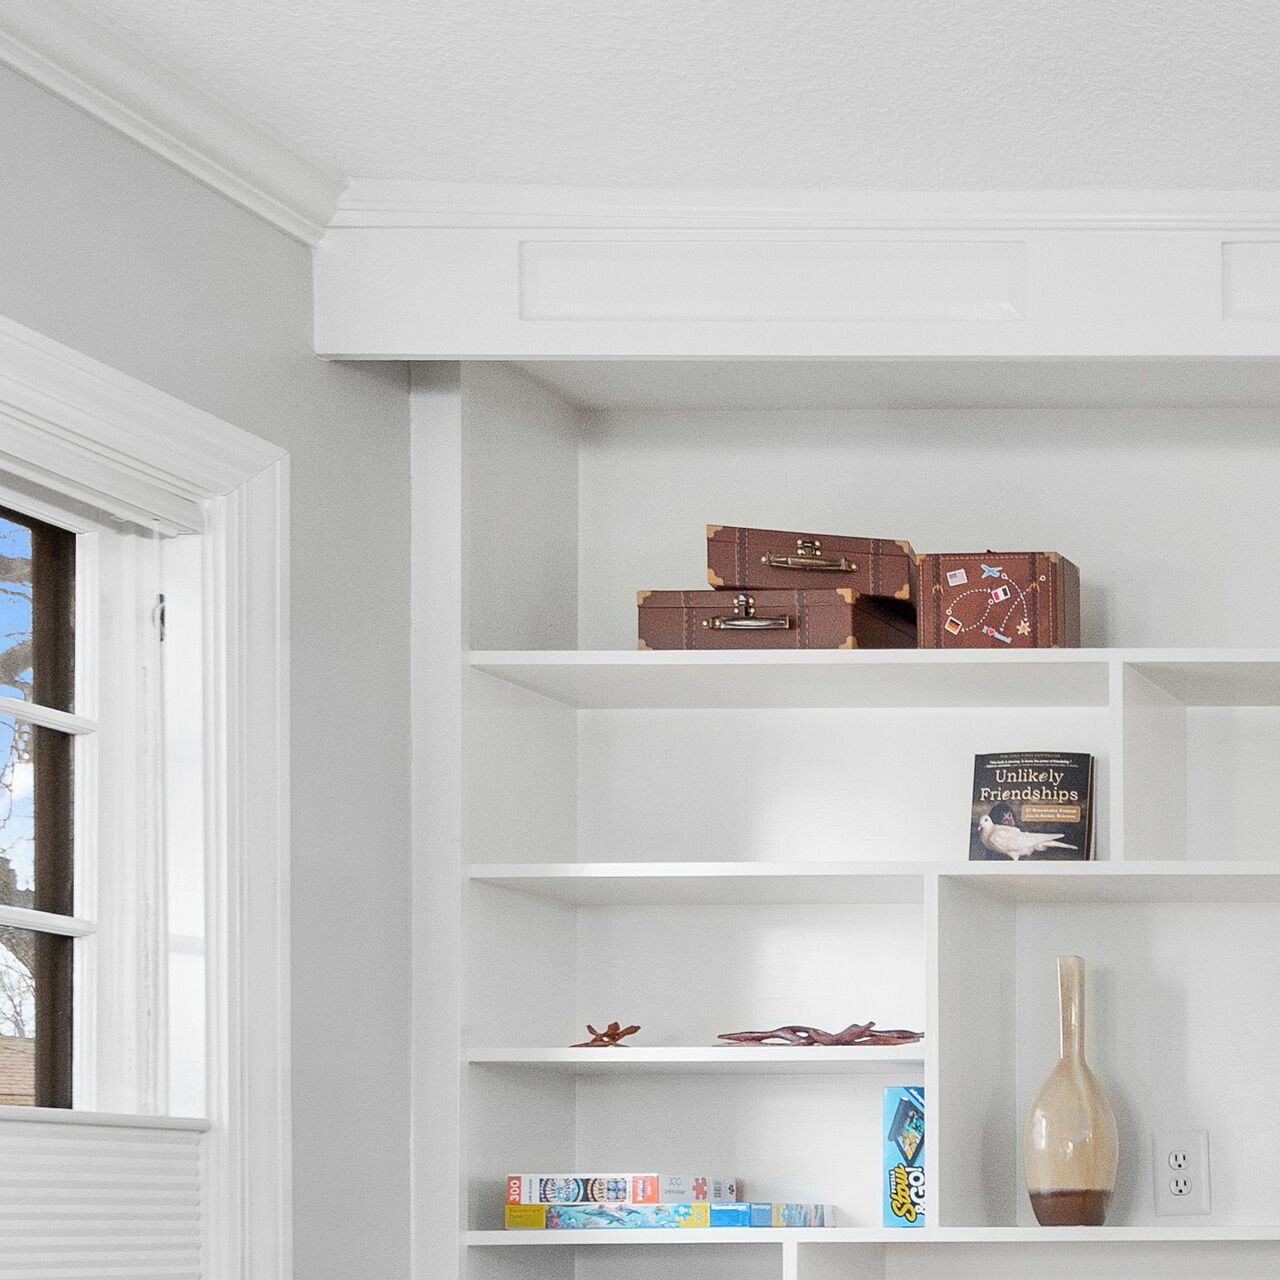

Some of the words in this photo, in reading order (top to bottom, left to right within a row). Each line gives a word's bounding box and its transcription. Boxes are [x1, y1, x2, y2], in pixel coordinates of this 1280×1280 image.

[995, 768, 1064, 785] Unlikely
[980, 786, 1078, 802] Friendships
[510, 1179, 520, 1201] 300
[891, 1163, 917, 1223] Stow
